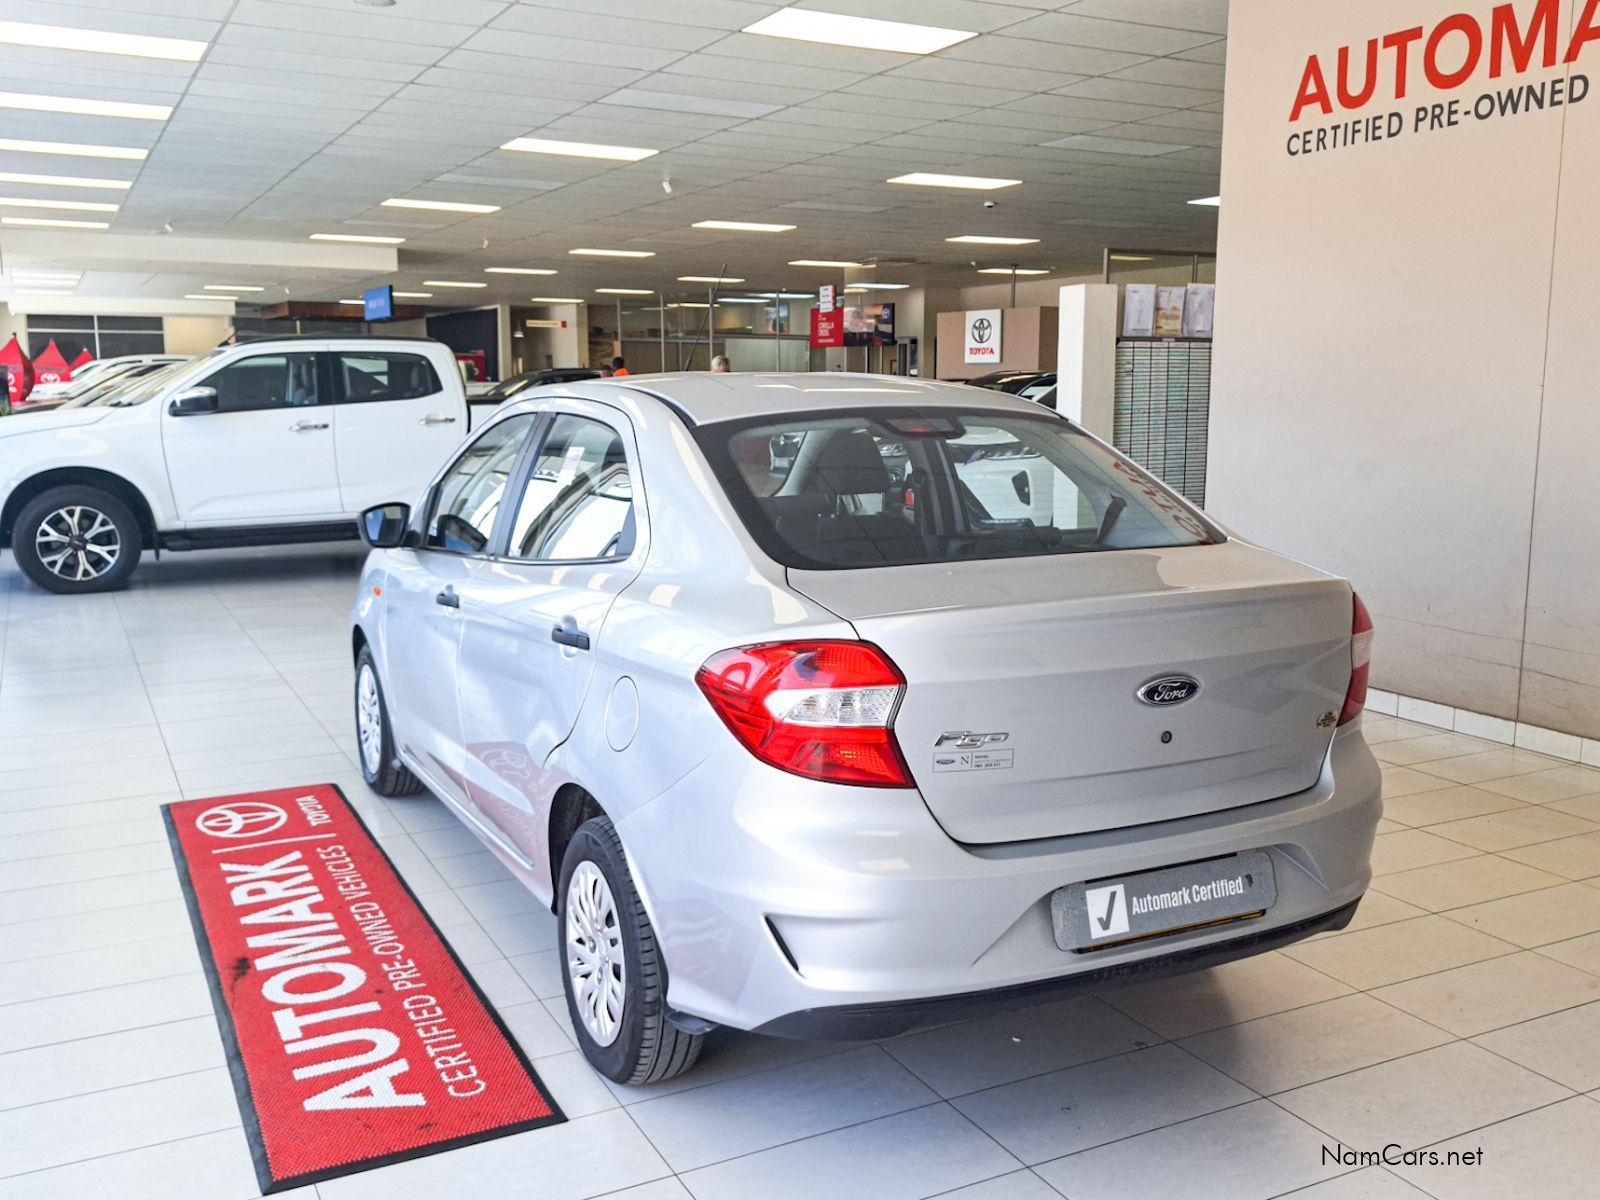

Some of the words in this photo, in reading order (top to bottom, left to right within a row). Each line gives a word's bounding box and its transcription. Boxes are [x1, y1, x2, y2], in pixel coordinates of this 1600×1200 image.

[1286, 111, 1404, 157] CERTIFIED
[1413, 73, 1591, 133] PRE-OWNED
[968, 346, 995, 356] TOYOTA
[1153, 681, 1190, 702] Ford
[933, 730, 1010, 750] Figo
[295, 795, 333, 828] TOYOTA
[316, 844, 372, 901] VEHICLES
[1131, 886, 1192, 916] Automark
[1191, 876, 1245, 902] Certified
[350, 901, 428, 992] PRE-OWNED
[219, 850, 428, 1112] AUTOMARK
[402, 994, 487, 1098] CERTIFIED
